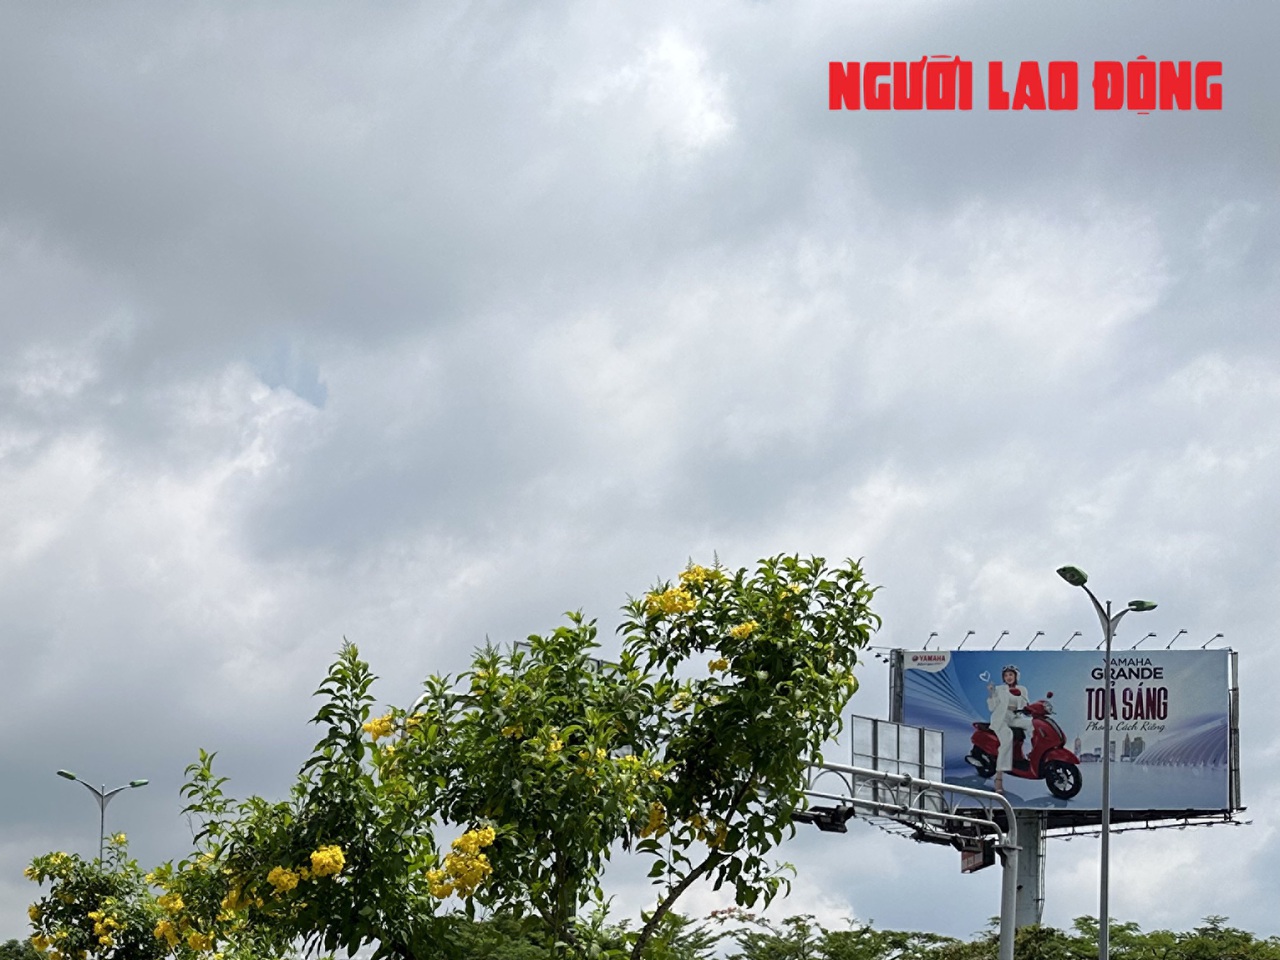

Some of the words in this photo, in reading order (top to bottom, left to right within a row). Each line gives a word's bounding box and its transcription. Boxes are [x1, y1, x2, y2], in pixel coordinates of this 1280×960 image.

[1091, 667, 1164, 680] GRANDE
[1122, 681, 1168, 721] SÁNG
[1115, 721, 1138, 731] Cách
[1140, 721, 1165, 732] Riêng
